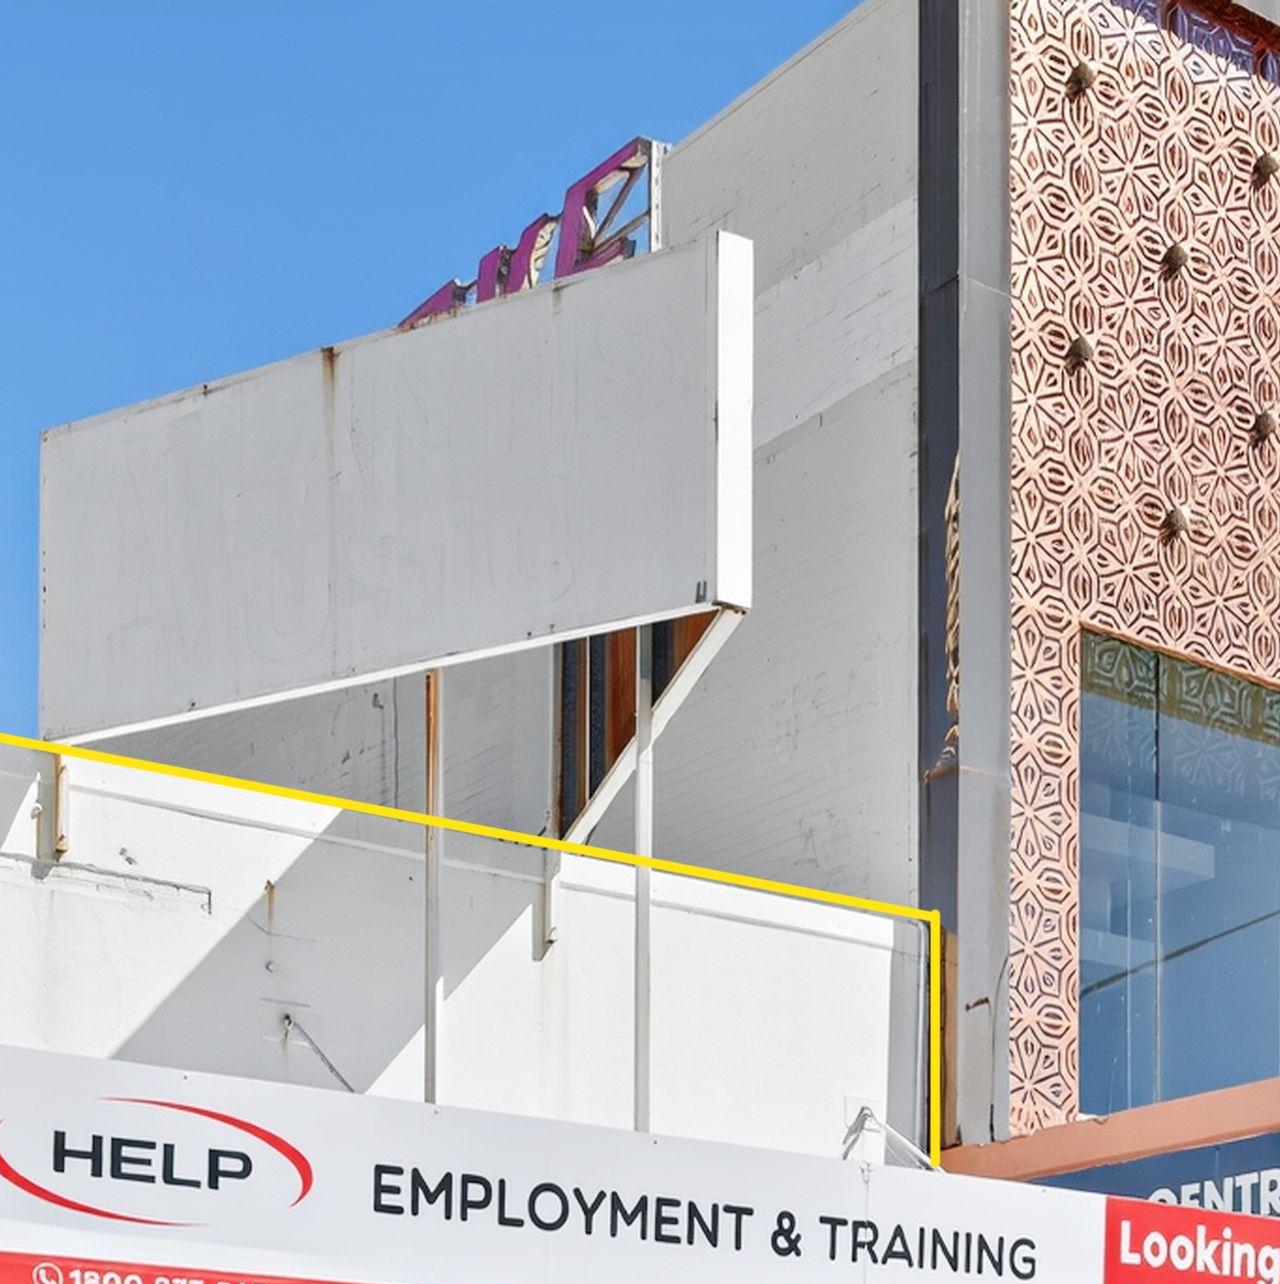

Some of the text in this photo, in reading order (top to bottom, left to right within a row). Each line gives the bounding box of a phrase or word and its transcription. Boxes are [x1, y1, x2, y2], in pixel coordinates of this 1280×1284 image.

[51, 1129, 253, 1191] HELP
[373, 1163, 1037, 1281] EMPLOYMENT & TRAINING
